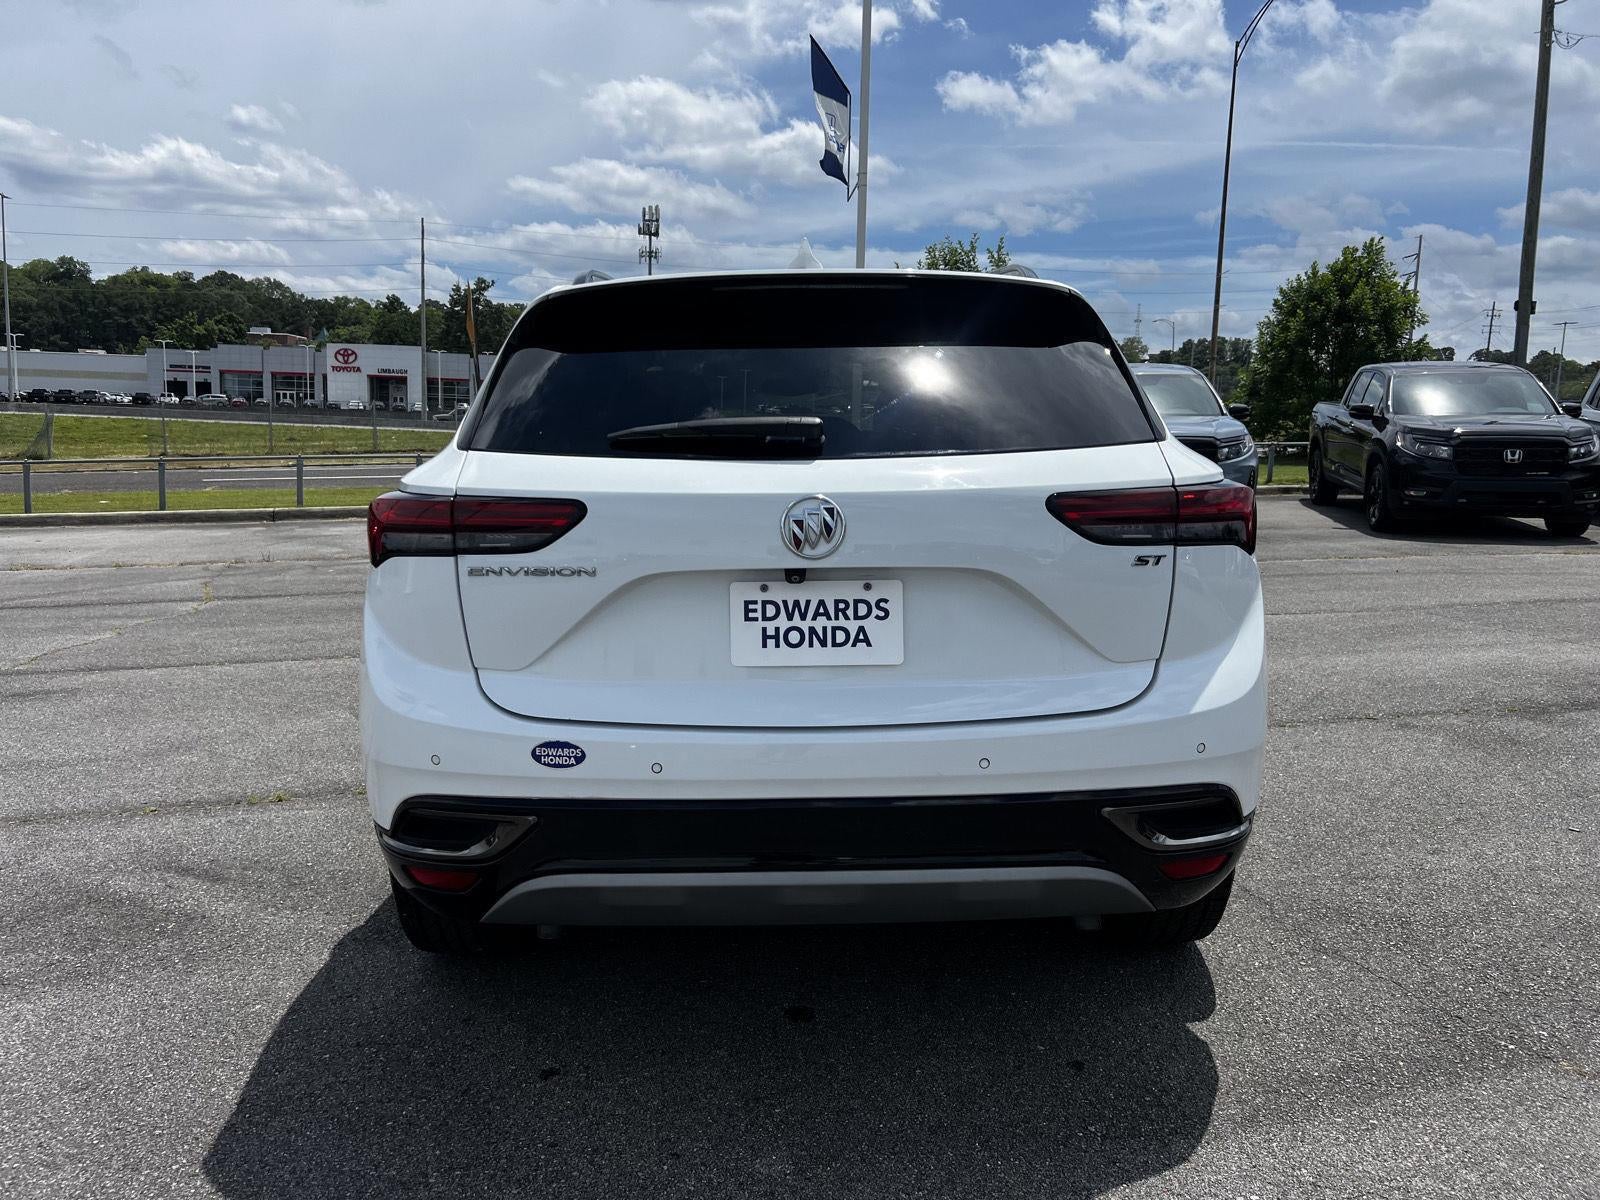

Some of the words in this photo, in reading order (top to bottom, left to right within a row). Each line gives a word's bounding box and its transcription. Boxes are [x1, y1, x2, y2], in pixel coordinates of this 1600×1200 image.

[1131, 554, 1167, 567] ST
[467, 566, 597, 577] ENVISION
[743, 598, 890, 622] EDWARDS
[761, 625, 873, 649] HONDA
[535, 747, 582, 757] EDWARDS
[541, 756, 576, 765] HONDA
